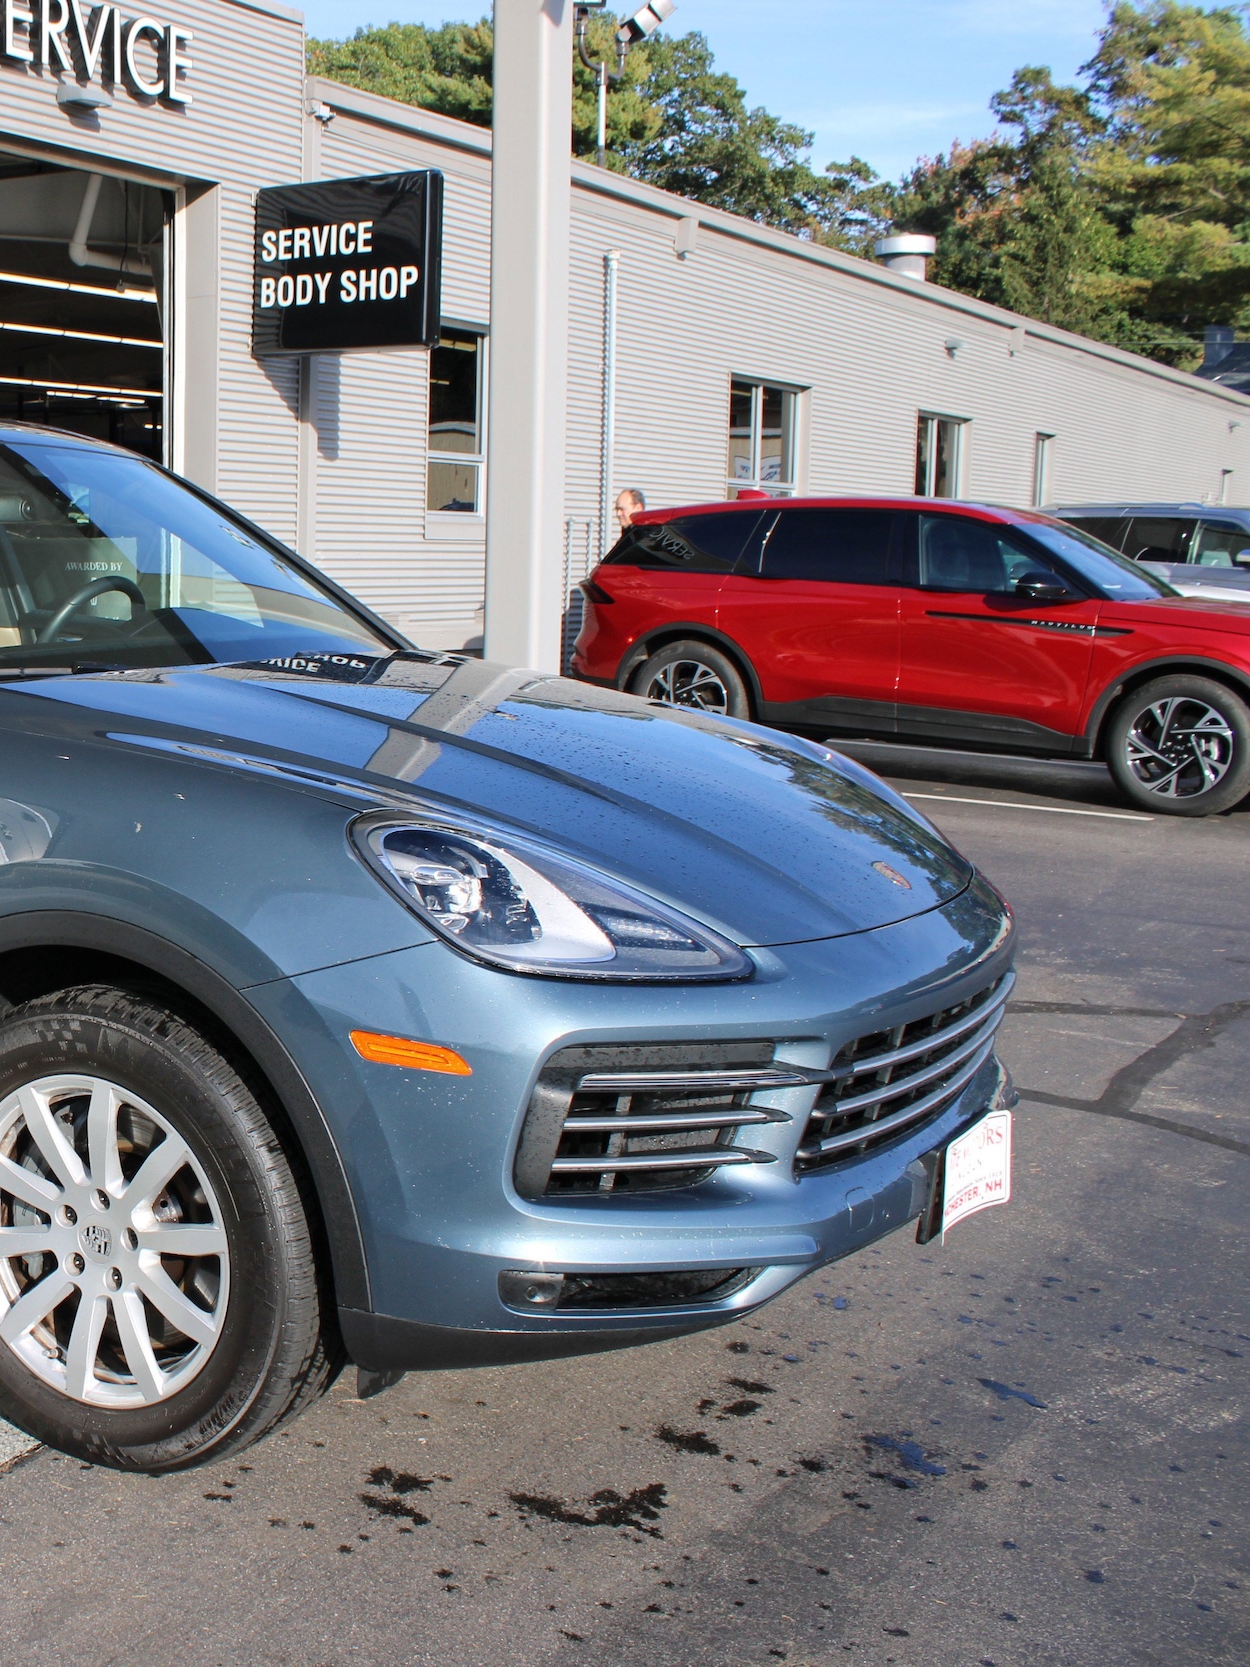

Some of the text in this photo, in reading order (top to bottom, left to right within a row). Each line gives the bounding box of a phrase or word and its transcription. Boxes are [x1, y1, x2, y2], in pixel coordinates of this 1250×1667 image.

[261, 221, 374, 263] SERVICE
[260, 265, 419, 309] BODY SHOP
[65, 562, 123, 571] AWARDED BY
[1031, 620, 1096, 630] NAUTILUS
[985, 1178, 1003, 1192] NH
